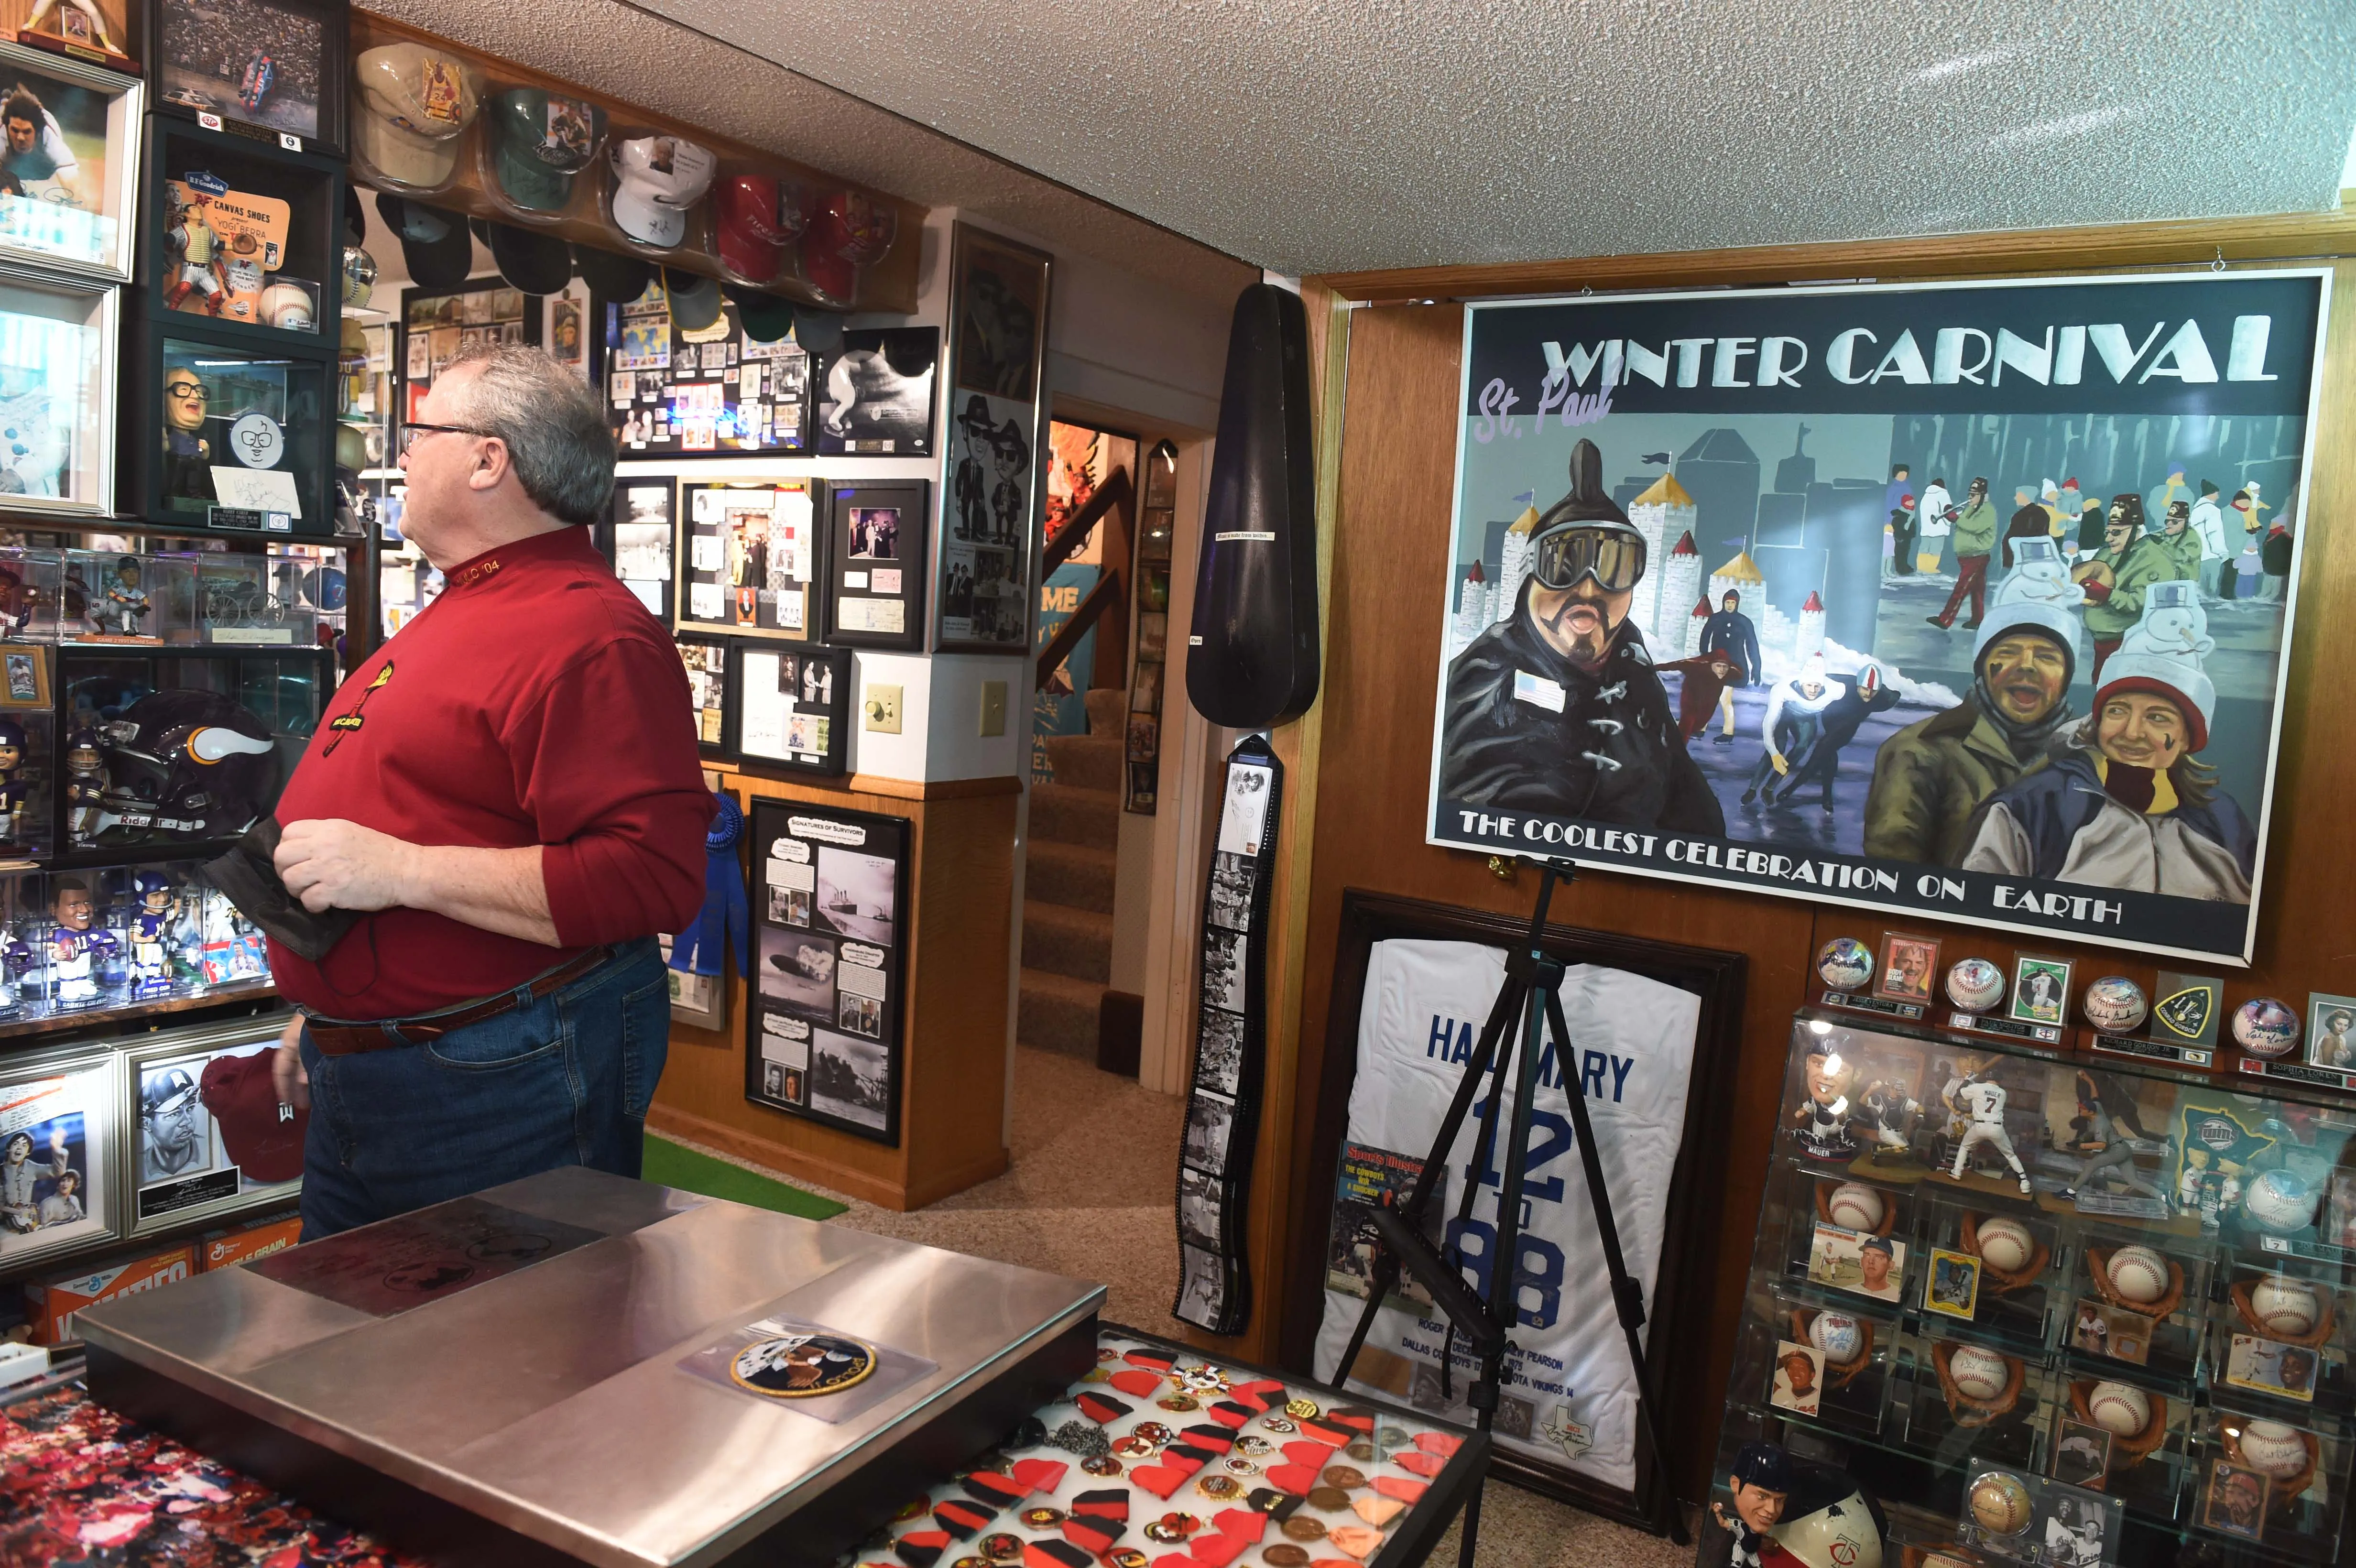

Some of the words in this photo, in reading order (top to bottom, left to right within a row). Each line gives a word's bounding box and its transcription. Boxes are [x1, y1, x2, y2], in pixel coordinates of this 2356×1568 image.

[215, 201, 244, 216] CANVAS
[247, 210, 270, 223] SHOES
[240, 225, 266, 239] BERRA
[1542, 337, 1808, 388] WINTER
[1826, 315, 2278, 387] CARNIVAL
[1473, 378, 1522, 444] St.
[1536, 355, 1625, 435] Paul
[482, 560, 499, 573] '04
[120, 815, 162, 827] Riddll
[833, 826, 863, 836] SURVIVORS
[1459, 811, 1516, 837] THE
[1524, 819, 1658, 857] COOLEST
[1665, 839, 1898, 893] CELEBRATION
[1917, 874, 1965, 901] ON
[1993, 885, 2122, 925] EARTH
[74, 936, 87, 950] 11
[1887, 975, 1903, 983] SLAM!
[2160, 1007, 2175, 1024] CONRAD
[2174, 1022, 2196, 1034] GORDON
[2104, 1037, 2132, 1046] RICHARD
[2134, 1042, 2160, 1050] GORDON
[2272, 1064, 2303, 1076] SOPHIA
[2308, 1069, 2337, 1079] LOREN
[1985, 1098, 1997, 1114] 7
[1347, 1146, 1385, 1165] Sports
[1464, 1096, 1572, 1203] 12
[1808, 1146, 1830, 1157] MAUER
[1345, 1165, 1355, 1173] THE
[1357, 1168, 1385, 1181] COWBOYS
[1833, 1226, 1854, 1235] LARSEN
[255, 1238, 285, 1258] GRAIN
[1418, 1318, 1444, 1335] ROGER
[1527, 1350, 1563, 1370] PEARSON
[1402, 1338, 1430, 1355] DALLAS
[1433, 1349, 1471, 1368] COBOYS
[1532, 1379, 1563, 1395] VIKINGS
